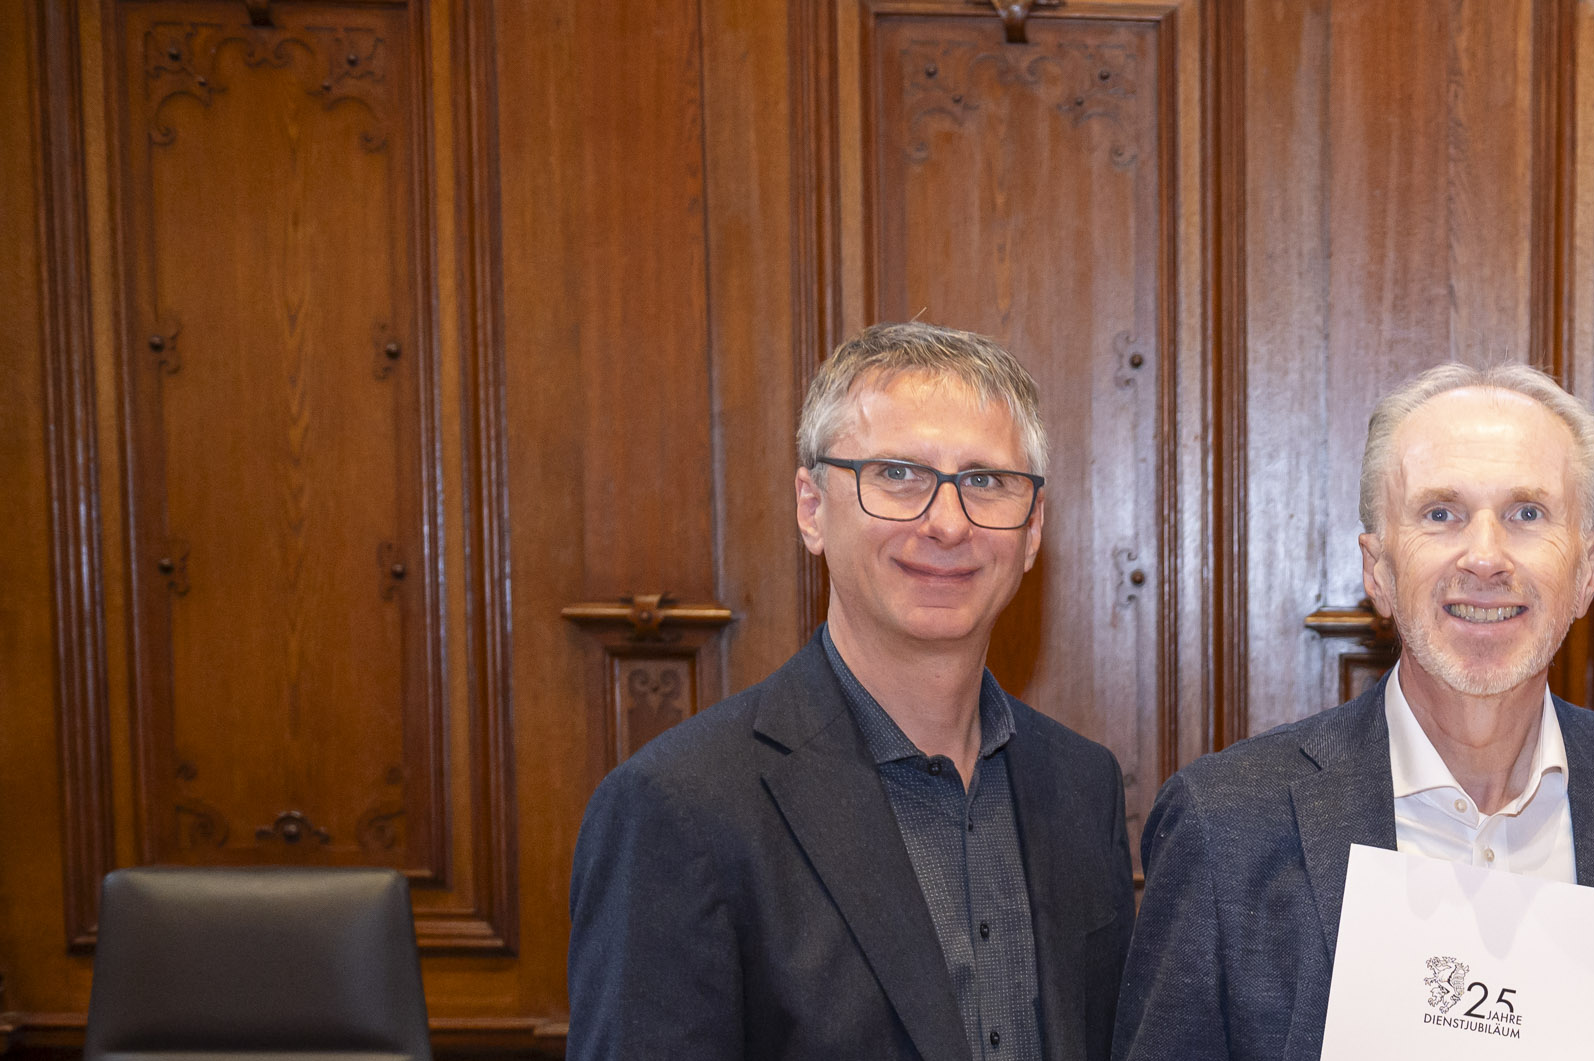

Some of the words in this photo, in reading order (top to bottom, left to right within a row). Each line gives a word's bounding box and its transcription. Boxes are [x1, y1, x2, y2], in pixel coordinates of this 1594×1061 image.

[1463, 981, 1516, 1019] 25
[1423, 1013, 1521, 1039] DIENSTJUBILÄUM
[1486, 1010, 1523, 1026] JAHRE
